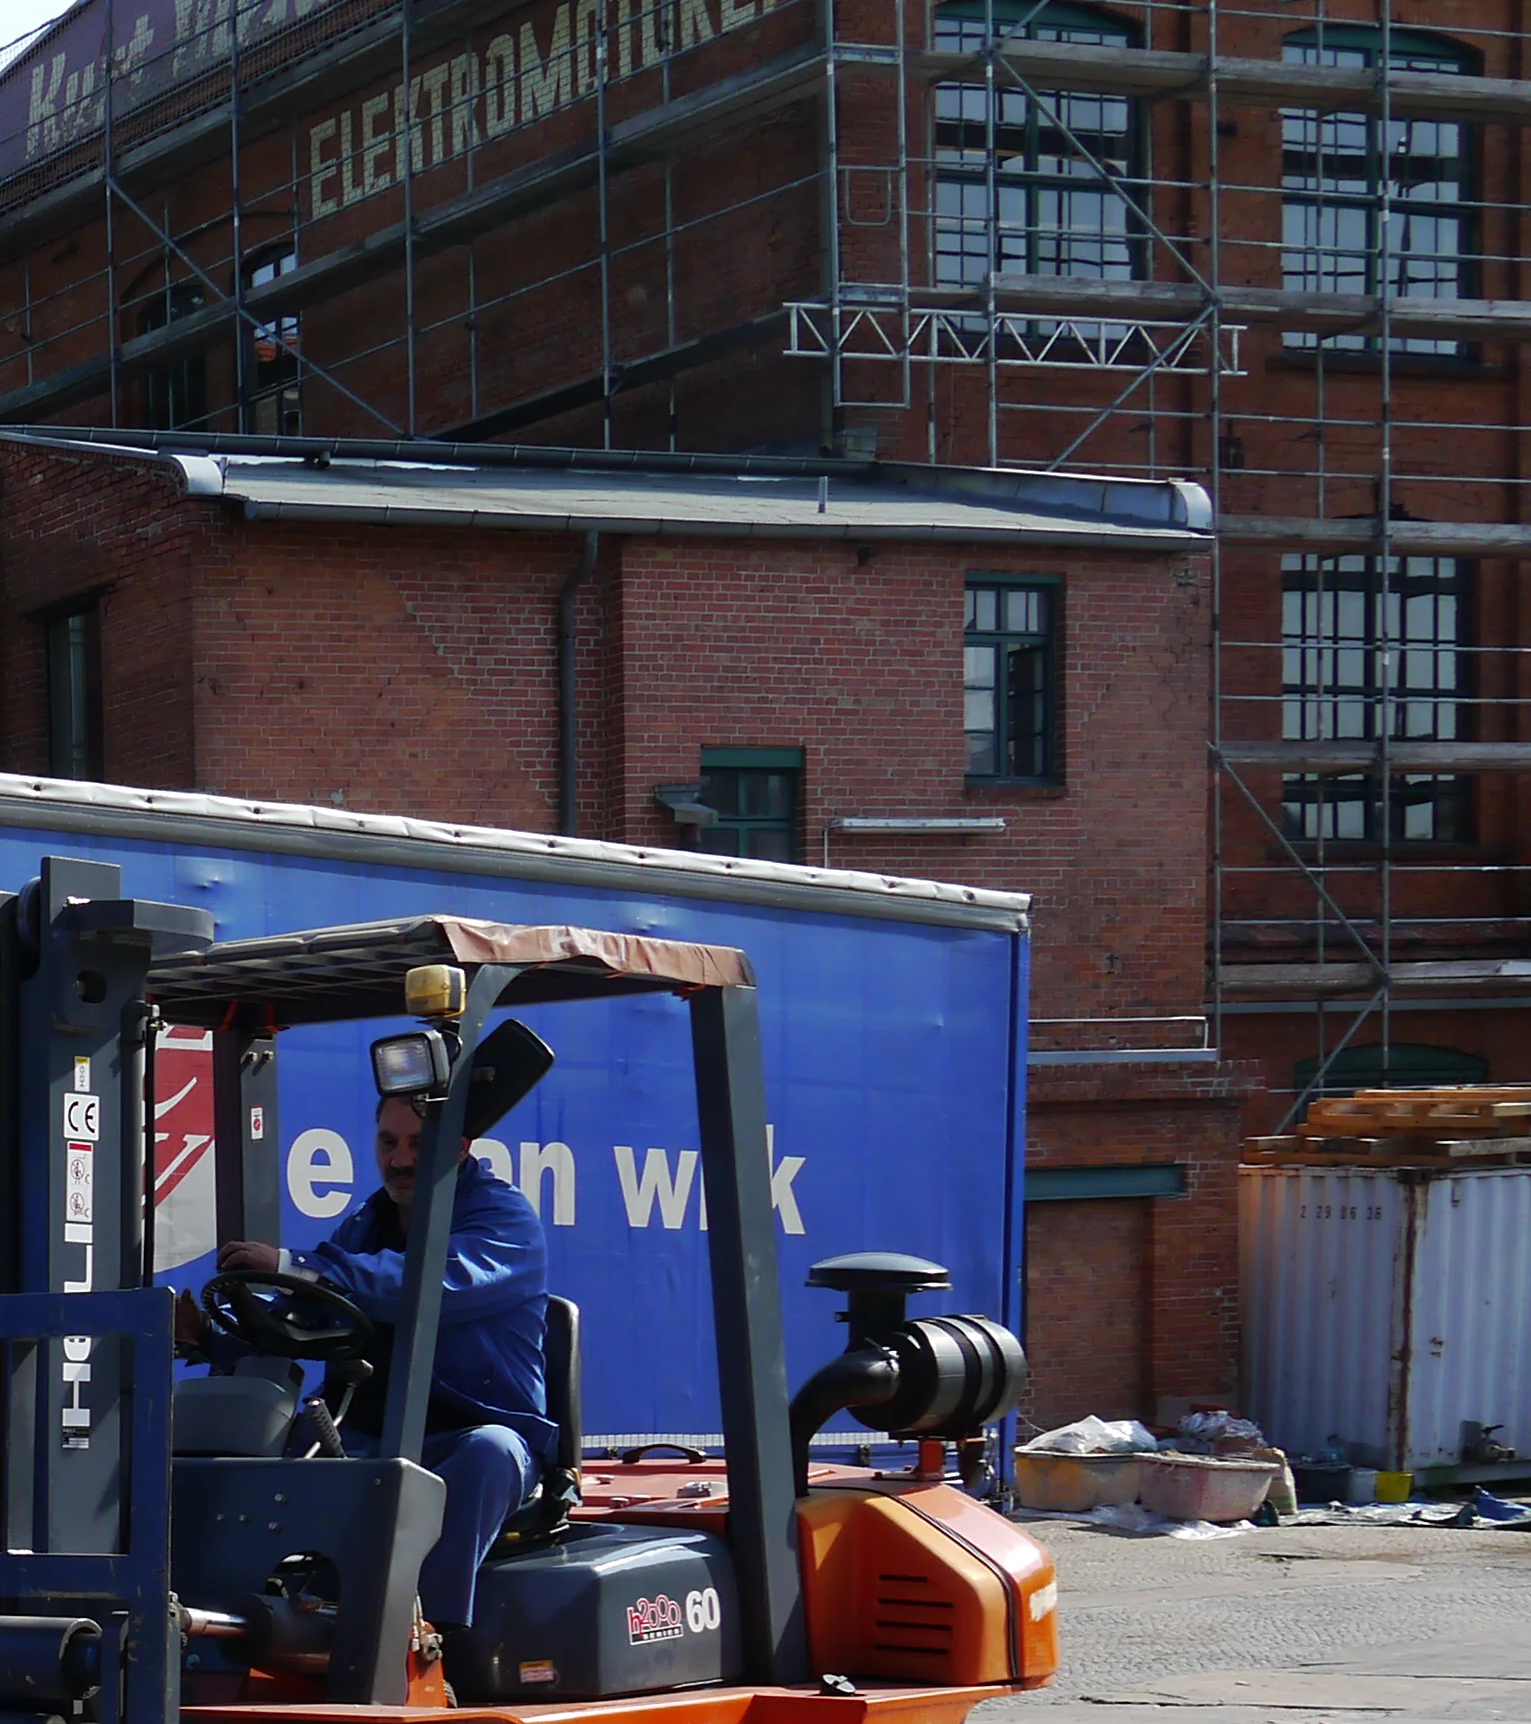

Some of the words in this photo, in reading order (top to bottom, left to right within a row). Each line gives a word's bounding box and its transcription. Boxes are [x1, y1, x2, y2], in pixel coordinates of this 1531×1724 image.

[309, 0, 777, 221] ELEKTROMOTO
[67, 1101, 96, 1134] CE
[286, 1127, 353, 1219] e
[614, 1124, 806, 1235] wk
[685, 1587, 721, 1633] 60
